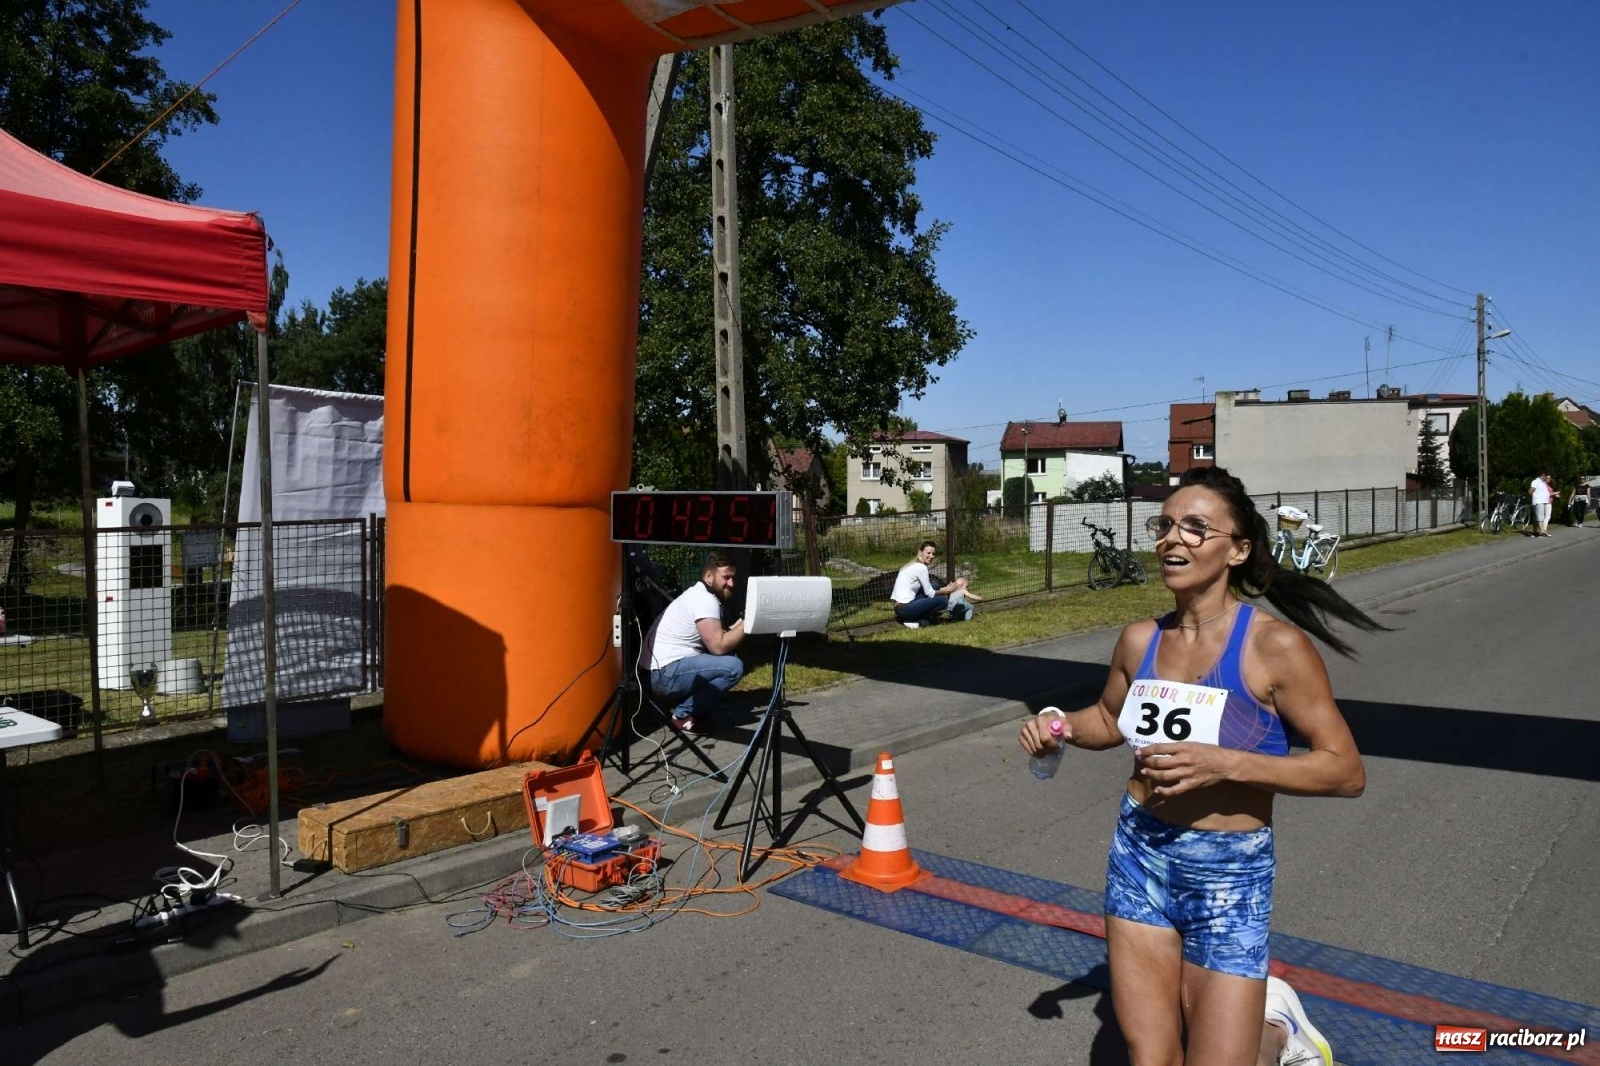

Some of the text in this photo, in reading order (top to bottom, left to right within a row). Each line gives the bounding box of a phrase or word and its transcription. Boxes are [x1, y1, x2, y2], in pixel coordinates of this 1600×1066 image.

[672, 496, 715, 541] 43
[729, 496, 776, 542] 51
[1132, 684, 1217, 706] COLOUR RUN
[1135, 702, 1192, 741] 36
